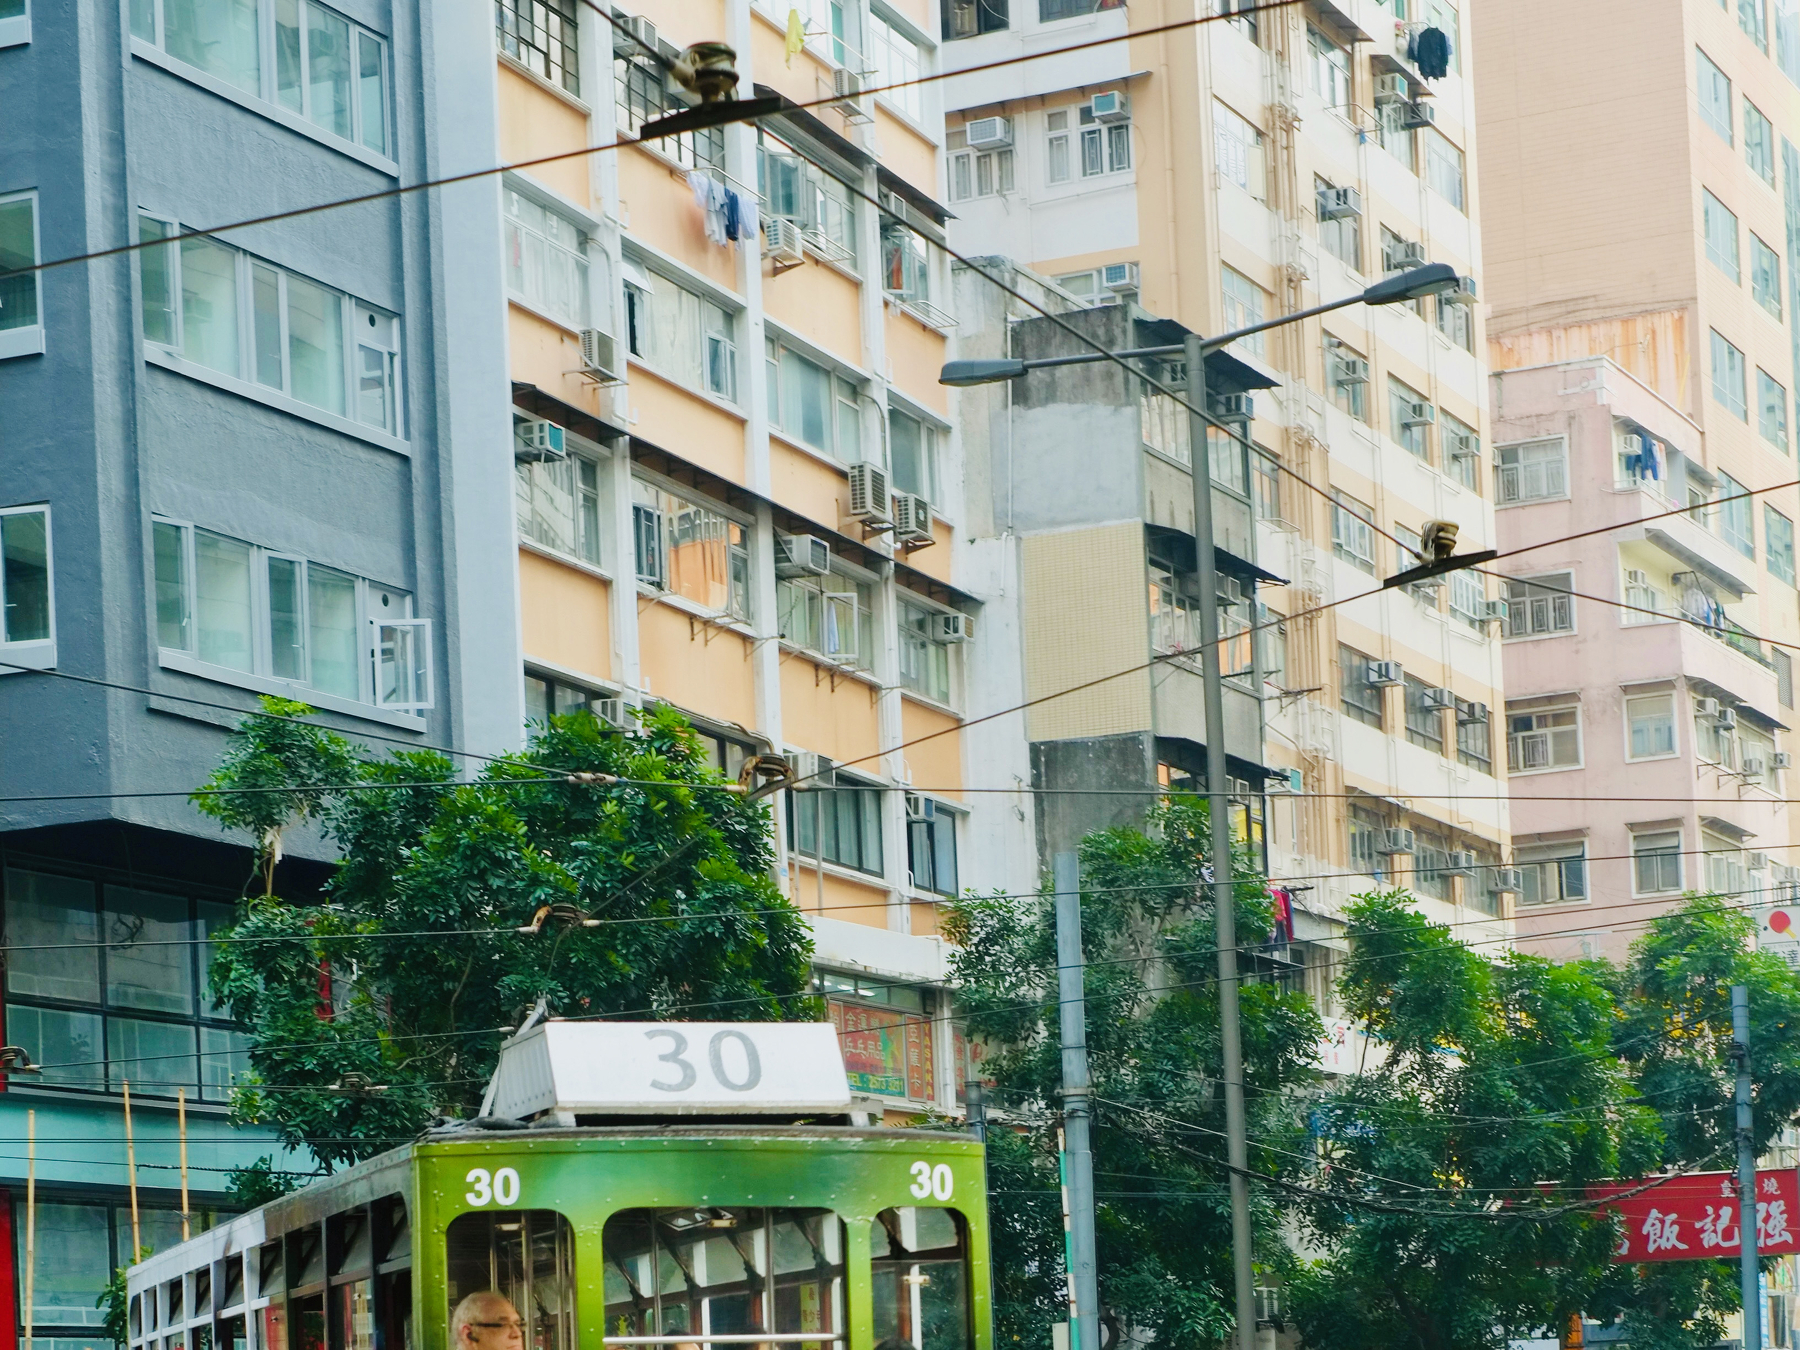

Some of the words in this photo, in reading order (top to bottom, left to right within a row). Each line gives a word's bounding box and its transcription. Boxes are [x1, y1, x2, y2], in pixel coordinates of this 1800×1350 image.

[644, 1028, 763, 1093] 30
[844, 1037, 886, 1061] 乒乓用品
[923, 1022, 934, 1095] YASAKA
[465, 1167, 521, 1207] 30
[909, 1161, 954, 1201] 30
[1721, 1177, 1781, 1198] 燒皇
